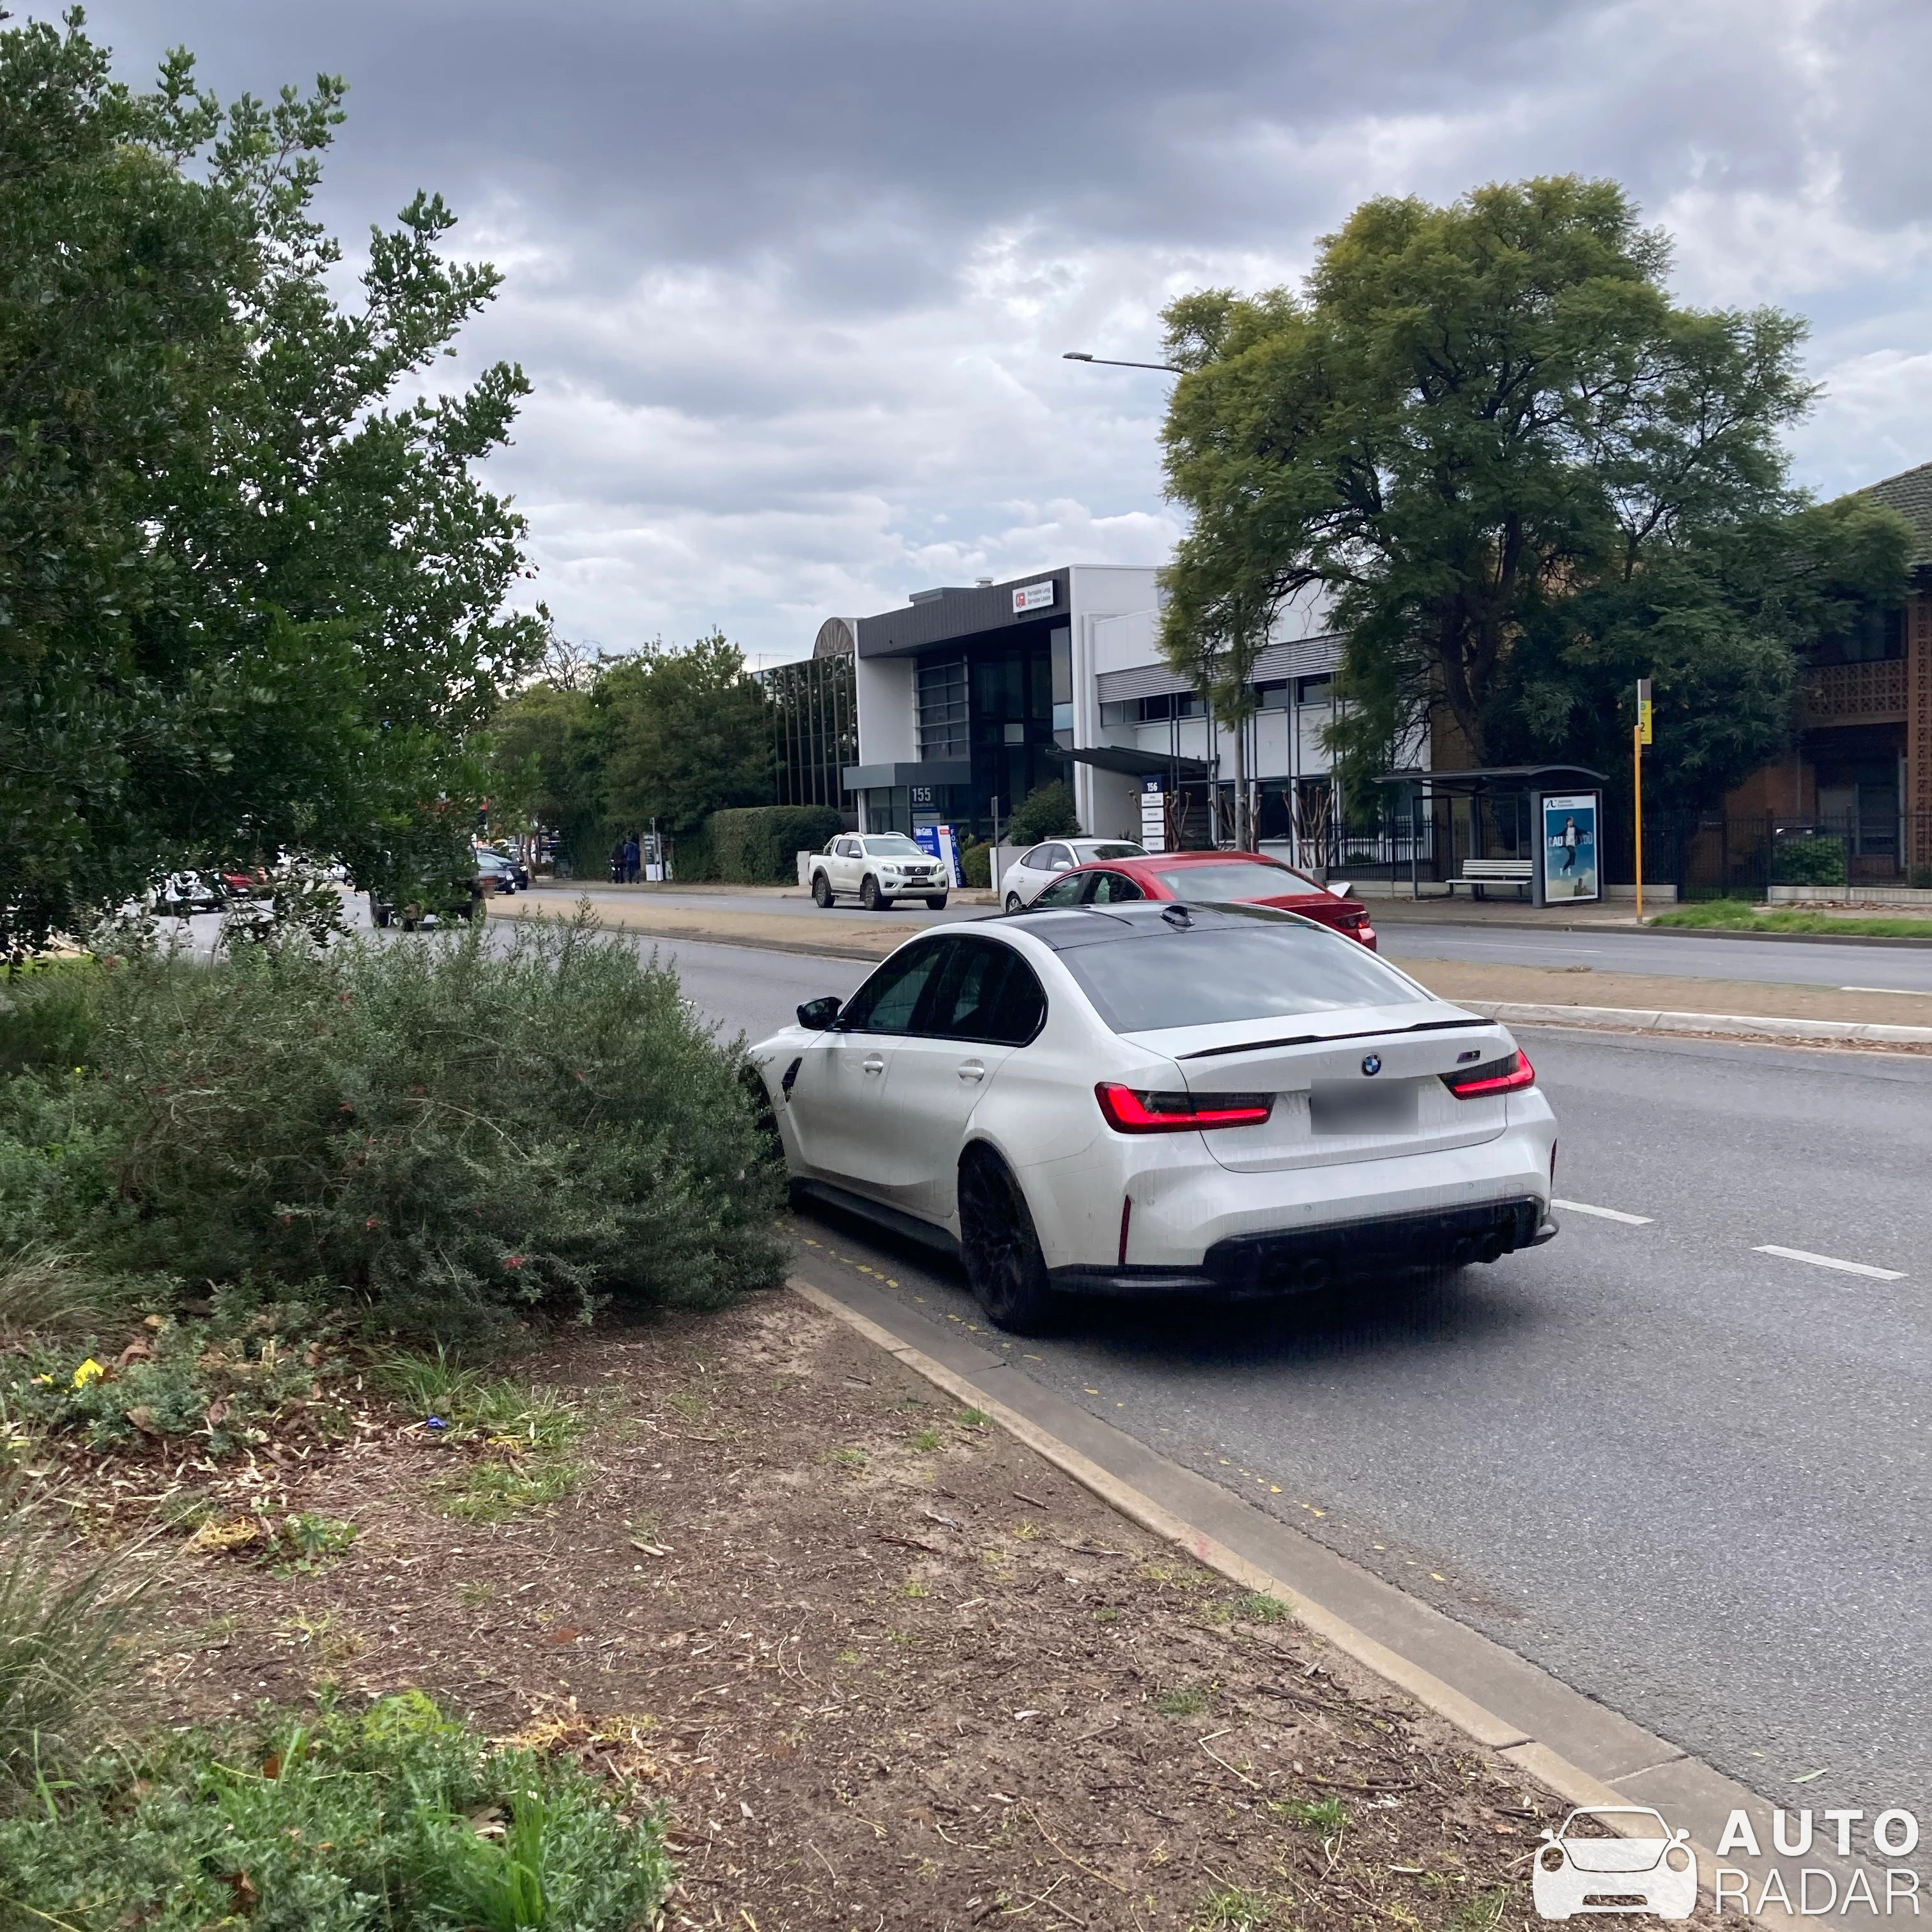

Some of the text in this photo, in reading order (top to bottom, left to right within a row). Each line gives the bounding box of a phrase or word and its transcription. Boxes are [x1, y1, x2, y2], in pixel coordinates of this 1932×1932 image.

[1147, 782, 1158, 792] 156
[912, 788, 931, 802] 155
[1548, 835, 1579, 847] LAUH
[953, 854, 962, 884] LEASE
